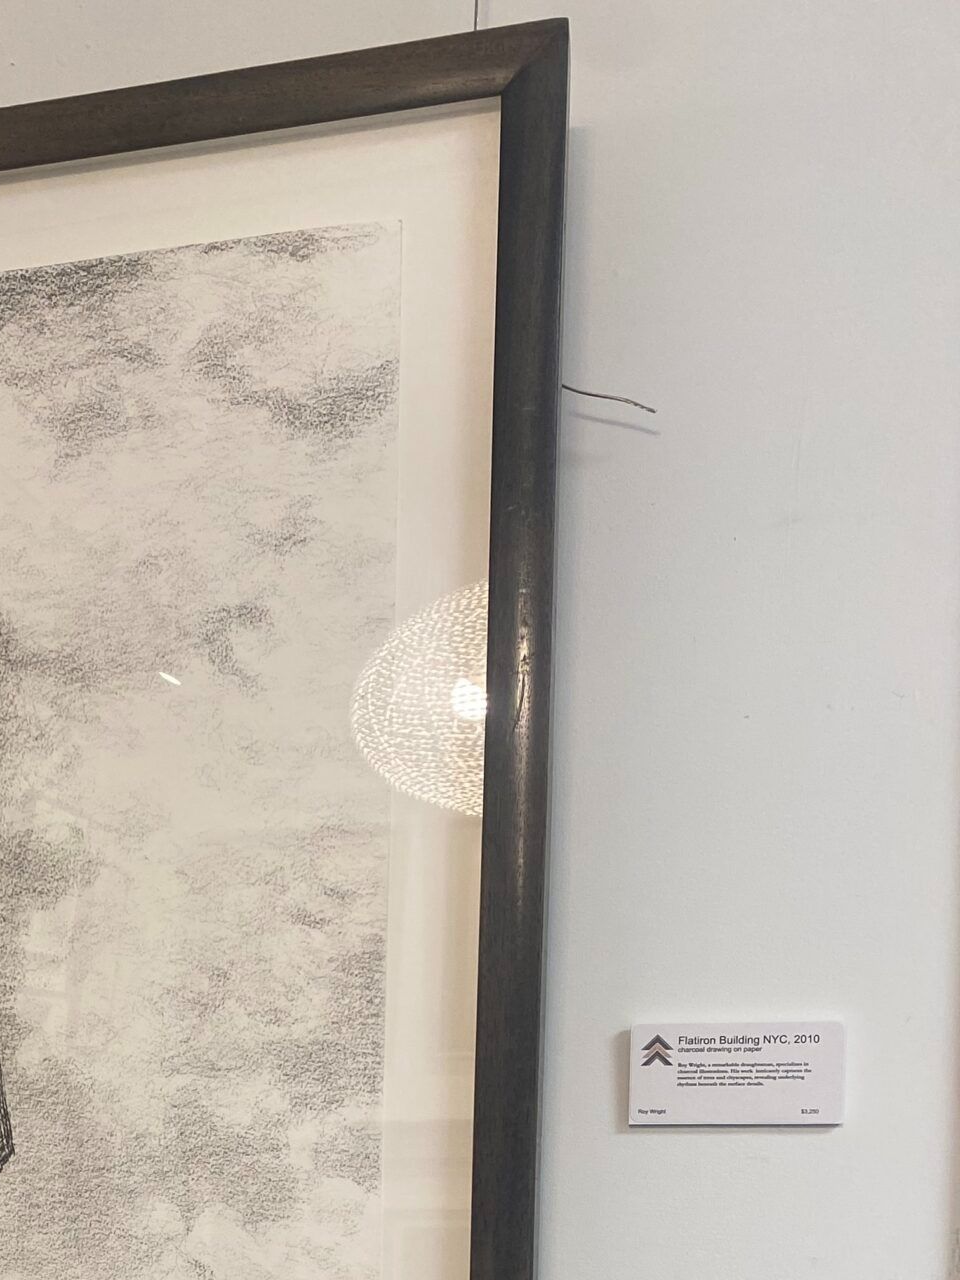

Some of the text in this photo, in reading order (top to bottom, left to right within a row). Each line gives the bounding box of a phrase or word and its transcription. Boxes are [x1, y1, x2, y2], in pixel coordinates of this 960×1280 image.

[678, 1034, 820, 1046] Flatiron Building NYC, 2010
